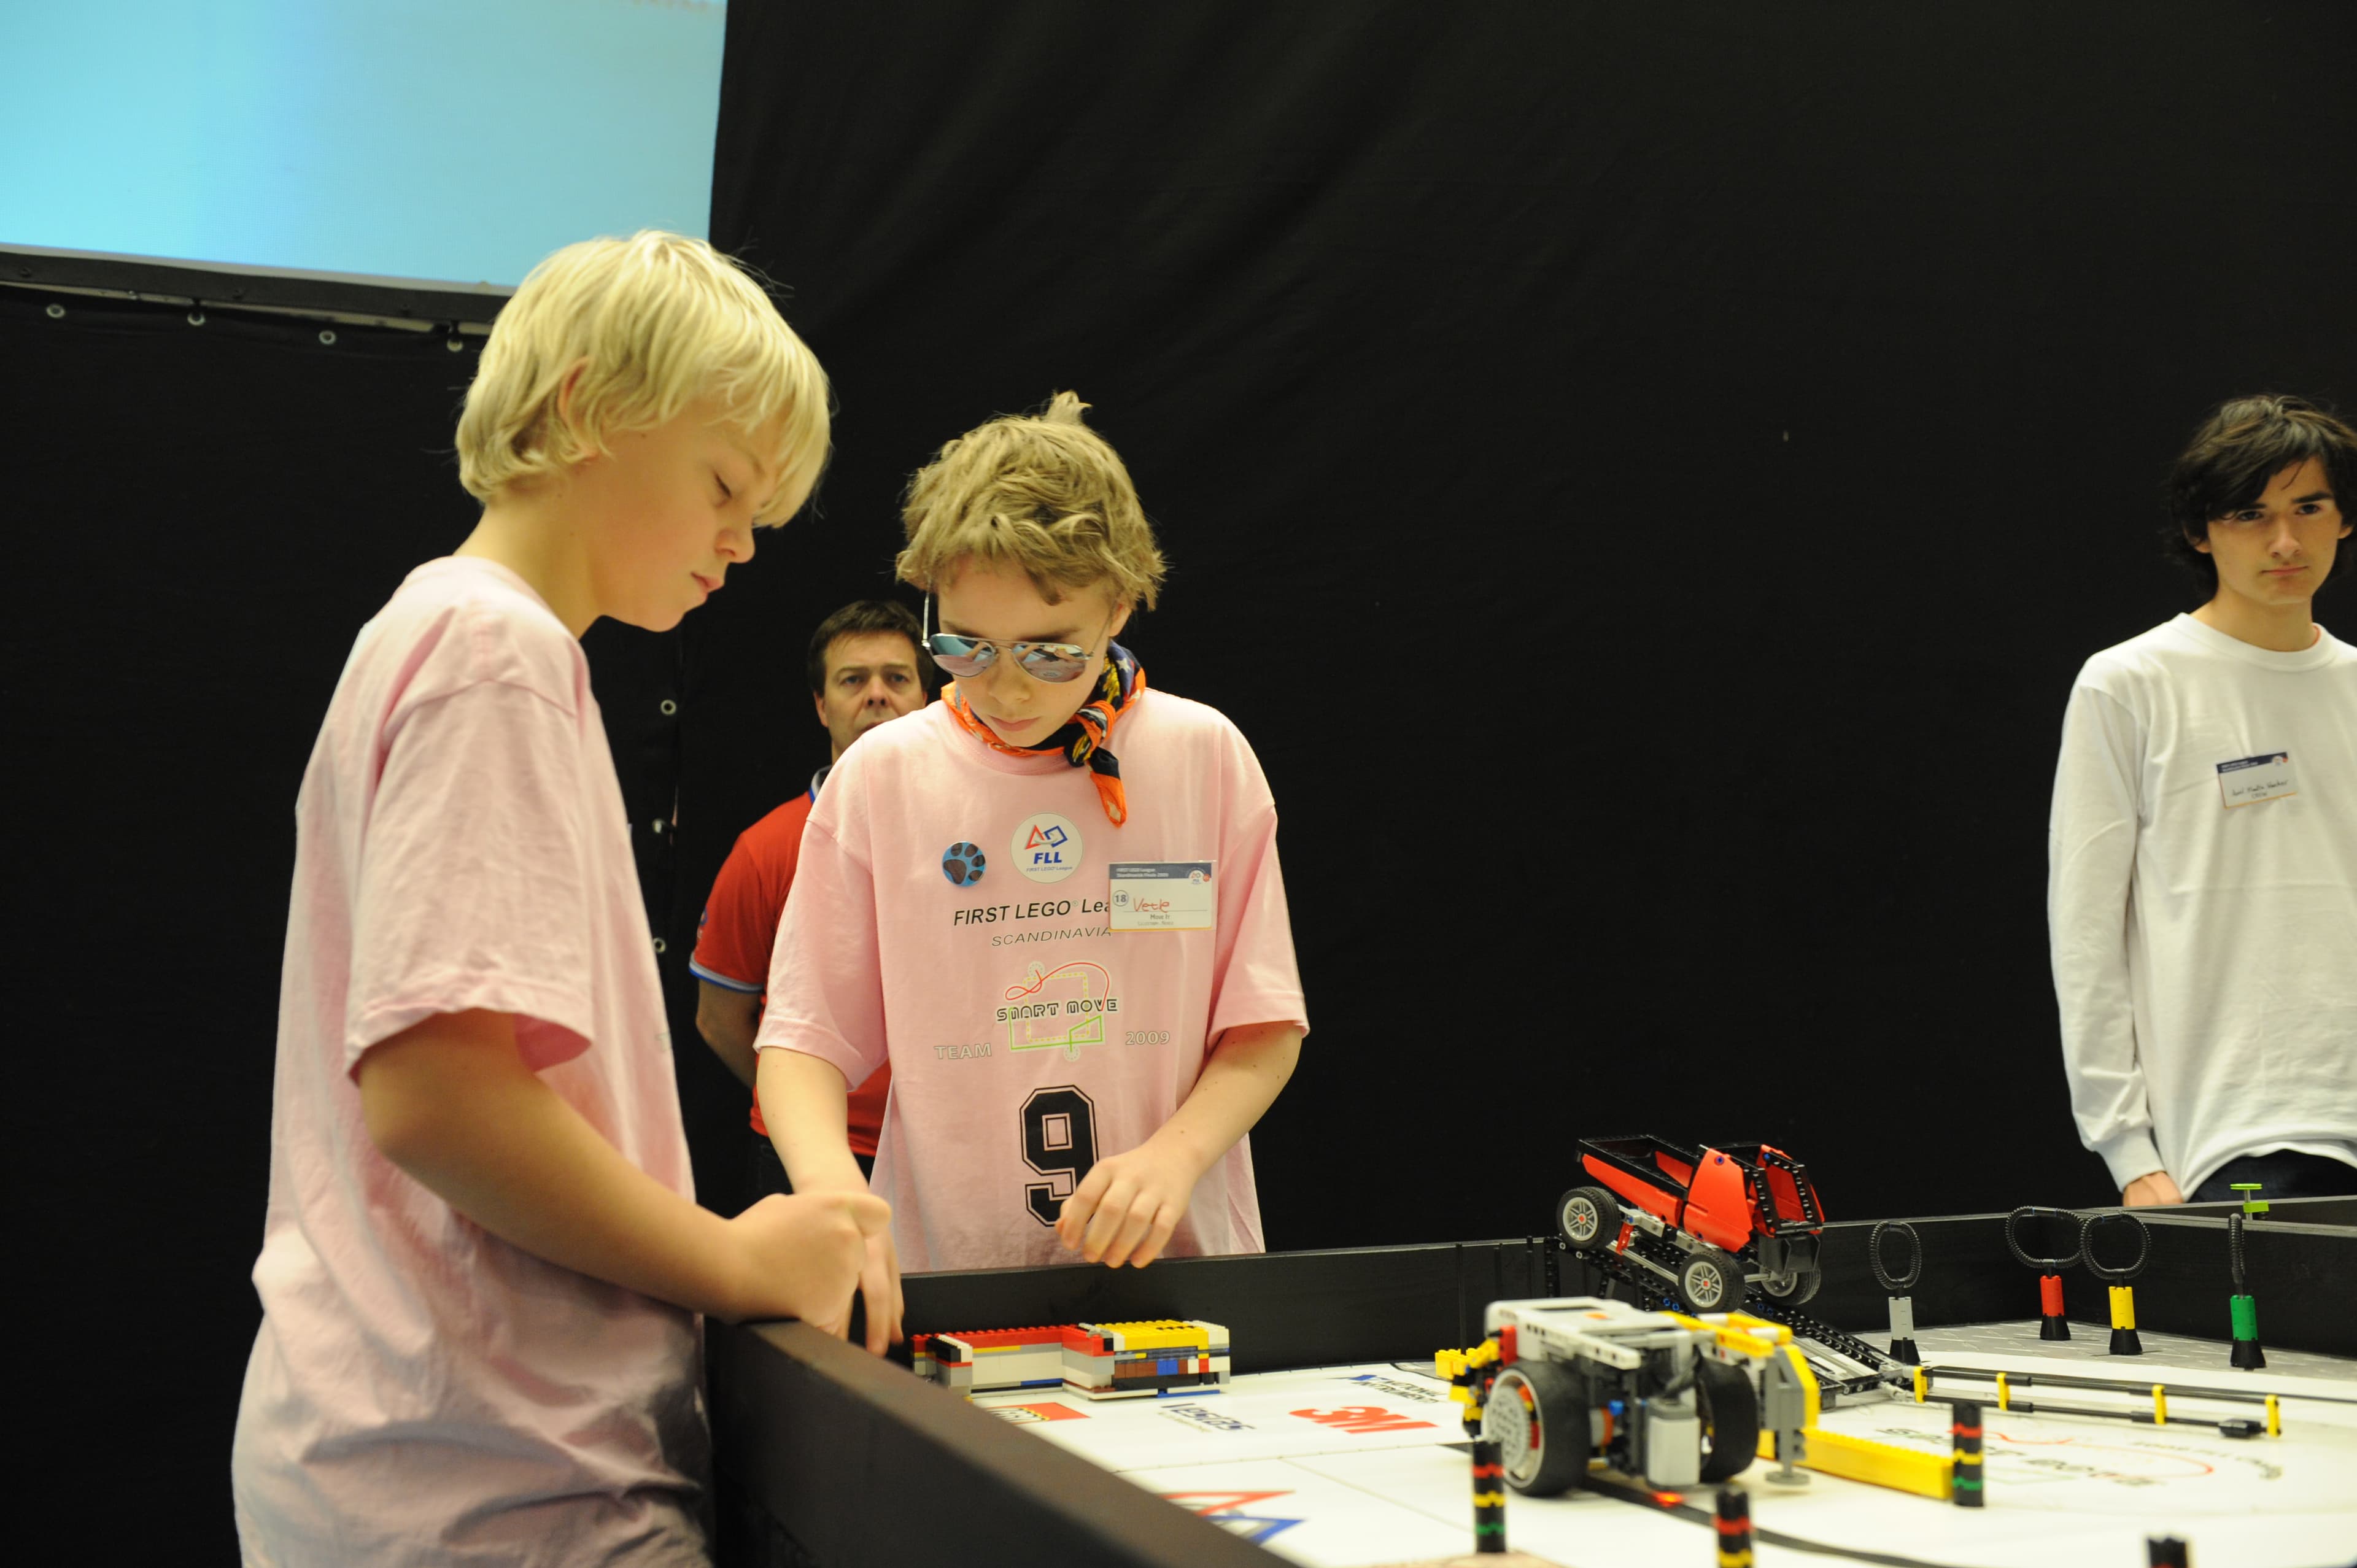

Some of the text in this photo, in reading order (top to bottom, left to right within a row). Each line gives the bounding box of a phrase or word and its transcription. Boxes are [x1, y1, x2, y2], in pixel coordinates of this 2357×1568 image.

[1033, 851, 1062, 865] FLL
[1114, 894, 1127, 903] 18
[954, 905, 1010, 926] FIRST
[1015, 900, 1071, 919] LEGO
[991, 927, 1112, 947] SCANDINAVIA
[997, 999, 1118, 1022] SMART MOVE
[934, 1031, 1171, 1060] TEAM 2009
[1019, 1085, 1099, 1227] 9
[1289, 1406, 1439, 1434] 3M
